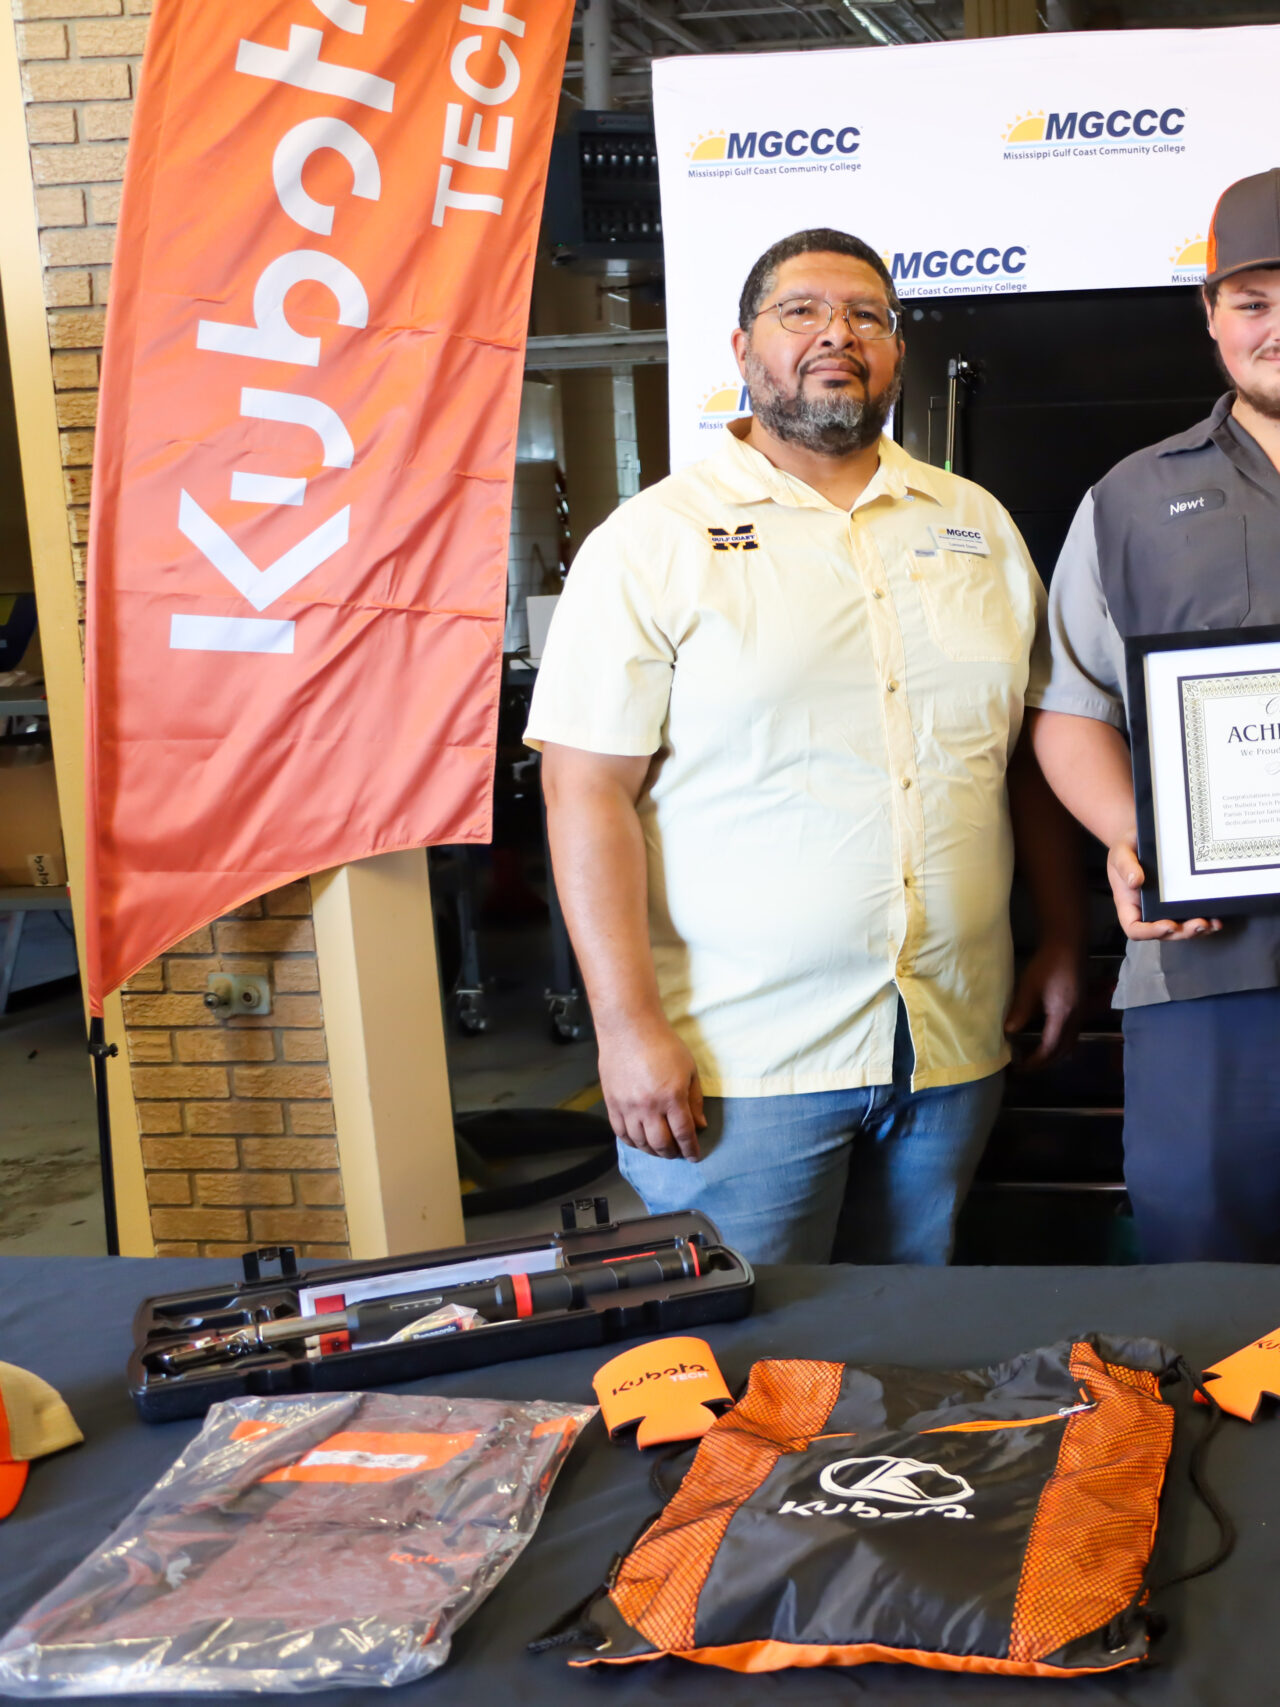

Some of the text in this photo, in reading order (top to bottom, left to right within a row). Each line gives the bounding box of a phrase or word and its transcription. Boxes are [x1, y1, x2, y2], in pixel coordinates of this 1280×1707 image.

[1045, 108, 1186, 141] MGCCC
[727, 126, 861, 159] MGCCC
[1004, 144, 1185, 160] Mississippi Gulf Coast Community College
[688, 162, 861, 179] Mississippi Gulf Coast Community College
[891, 246, 1027, 279] MGCCC
[897, 282, 1027, 297] Gulf Coast Community College
[1169, 496, 1205, 516] Newt
[946, 528, 981, 539] MGCCC
[1240, 749, 1253, 757] We
[612, 1363, 706, 1396] Kubota
[669, 1371, 709, 1382] TECH
